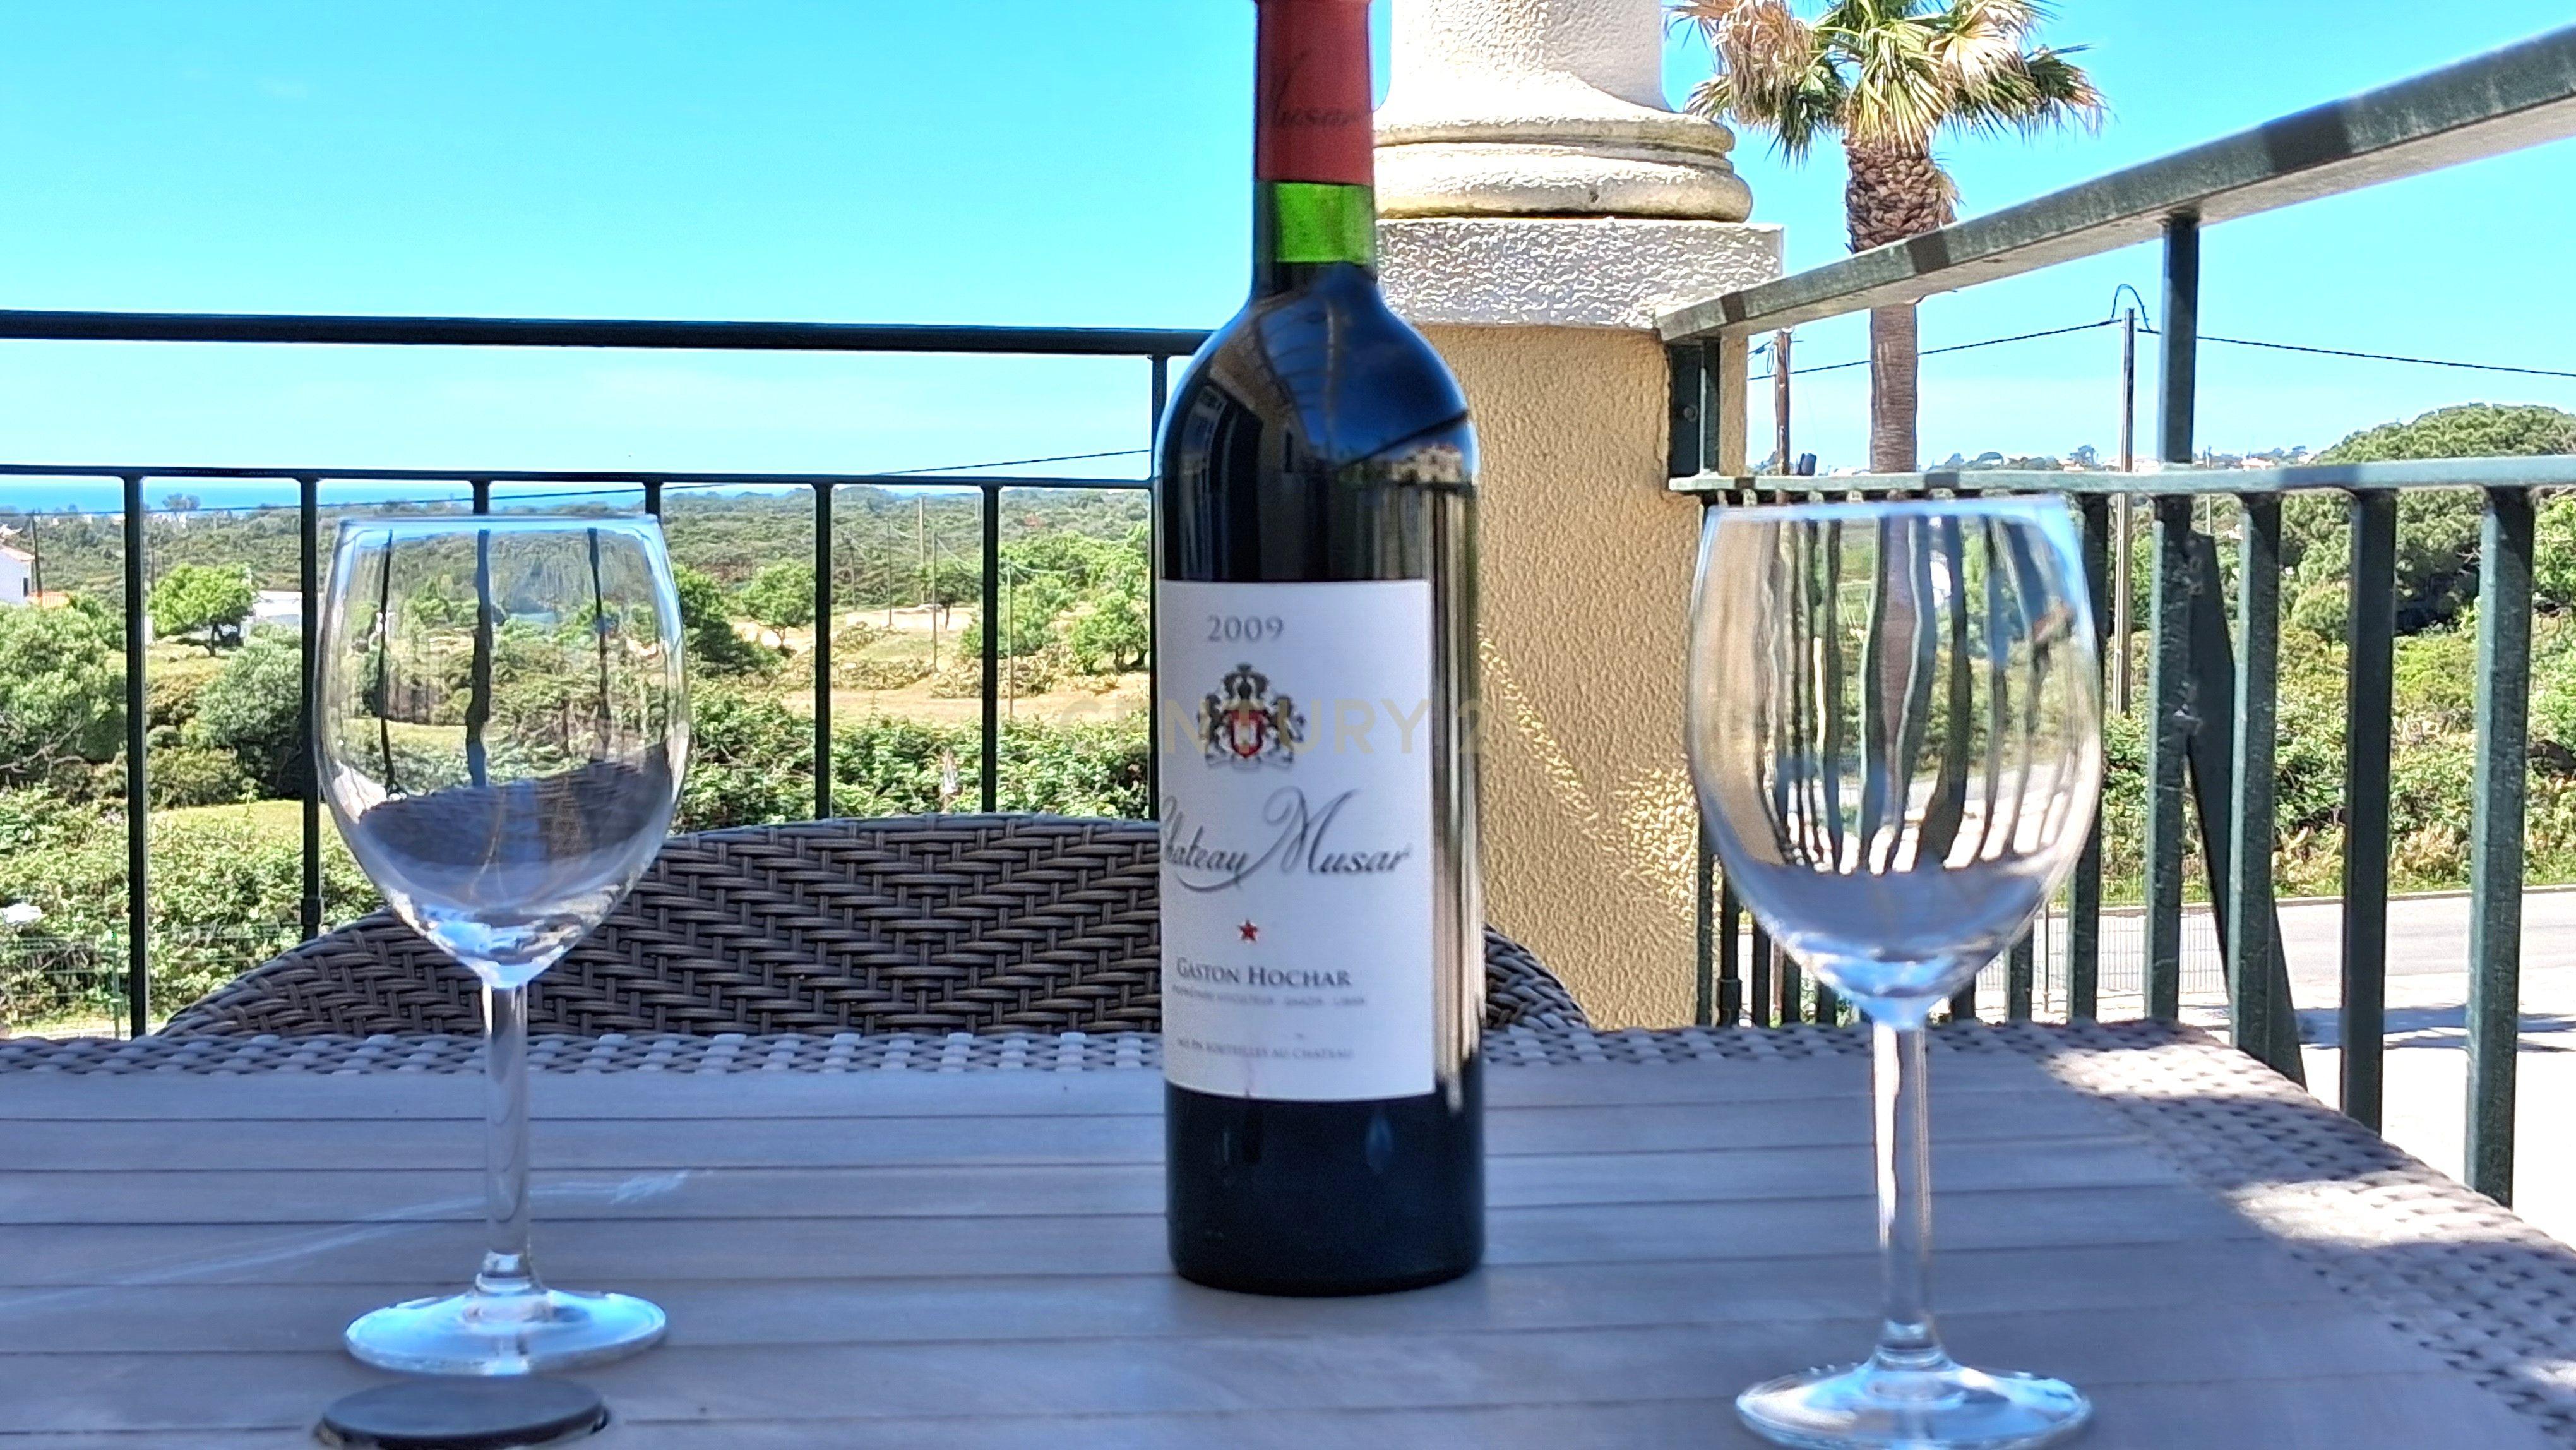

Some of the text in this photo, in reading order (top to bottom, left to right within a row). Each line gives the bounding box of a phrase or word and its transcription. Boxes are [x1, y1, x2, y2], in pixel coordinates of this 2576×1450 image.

[1207, 614, 1285, 642] 2009
[1241, 785, 1412, 884] Musar
[1176, 956, 1352, 988] GASTON HOCHAR
